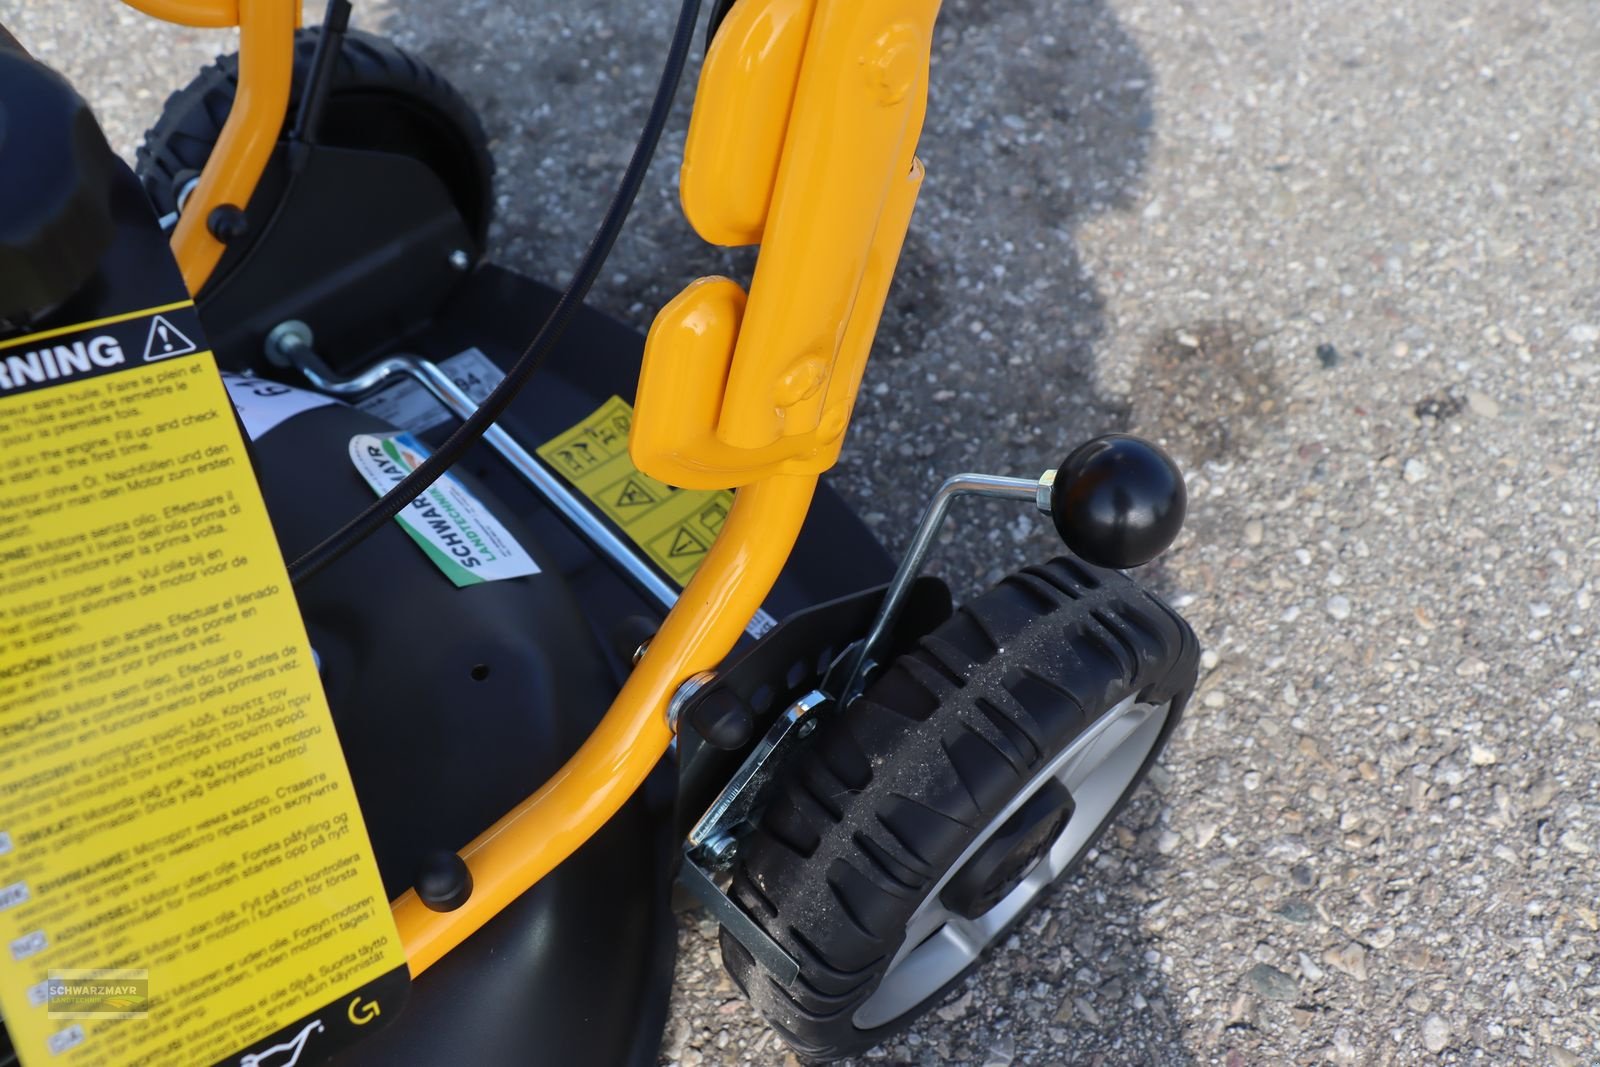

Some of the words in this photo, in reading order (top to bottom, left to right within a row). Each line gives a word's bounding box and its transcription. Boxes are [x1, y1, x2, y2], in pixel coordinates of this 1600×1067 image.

[99, 398, 116, 409] de
[119, 386, 173, 404] remettre
[175, 382, 188, 391] le
[106, 379, 138, 393] Faire
[142, 375, 153, 384] le
[156, 368, 187, 383] plein
[189, 363, 202, 374] et
[114, 430, 132, 442] Fill
[135, 427, 153, 437] up
[155, 418, 178, 432] and
[181, 409, 219, 426] check
[104, 458, 174, 482] Nachfüllen
[177, 449, 202, 464] und
[203, 445, 229, 457] den
[126, 475, 166, 491] Motor
[167, 468, 194, 481] zum
[196, 457, 234, 473] ersten
[162, 496, 224, 519] Effettuare
[226, 491, 234, 502] il
[190, 511, 226, 529] prima
[229, 504, 241, 515] di
[113, 551, 136, 566] per
[138, 547, 151, 556] la
[154, 536, 191, 554] prima
[194, 527, 227, 541] volta.
[137, 566, 160, 581] Vul
[162, 561, 186, 574] olie
[188, 553, 205, 566] bij
[207, 550, 223, 561] en
[138, 584, 156, 596] de
[159, 572, 197, 590] motor
[200, 563, 229, 577] voor
[230, 557, 248, 568] de
[167, 604, 219, 626] Efectuar
[222, 597, 233, 609] el
[234, 585, 279, 605] llenado
[143, 632, 178, 649] antes
[180, 626, 198, 637] de
[202, 613, 237, 633] poner
[240, 607, 257, 618] en
[147, 642, 196, 666] primera
[199, 635, 224, 648] vez.
[177, 655, 230, 678] Efectuar
[234, 651, 242, 659] o
[196, 674, 214, 685] do
[217, 664, 243, 678] óleo
[246, 651, 279, 668] antes
[282, 645, 297, 656] de
[198, 686, 225, 703] pela
[227, 668, 275, 693] primeira
[278, 660, 300, 673] vez.
[268, 689, 288, 701] τον
[288, 693, 312, 707] πριν
[206, 760, 265, 790] seviyesini
[267, 743, 307, 766] kontrol
[216, 747, 264, 771] koyunuz
[268, 740, 281, 751] ve
[283, 725, 321, 745] motoru
[250, 811, 266, 825] да
[268, 805, 281, 816] го
[283, 781, 338, 809] вклучите
[275, 772, 327, 798] Ставете
[242, 842, 281, 863] Foreta
[283, 820, 334, 848] påfylling
[336, 814, 348, 824] og
[242, 855, 281, 877] startes
[284, 844, 308, 859] opp
[310, 834, 325, 849] på
[328, 824, 349, 840] nytt
[258, 891, 305, 918] funktion
[307, 883, 323, 895] för
[325, 868, 357, 887] första
[265, 887, 279, 903] på
[282, 877, 302, 893] och
[304, 854, 360, 883] kontrollera
[241, 944, 270, 963] uden
[292, 917, 328, 939] Forsyn
[331, 895, 374, 921] motoren
[290, 928, 336, 955] motoren
[338, 912, 368, 931] tages
[370, 907, 375, 916] i
[303, 981, 326, 997] kuin
[328, 950, 384, 984] käynnistät
[318, 952, 356, 975] Suorita
[358, 935, 387, 956] täyttö
